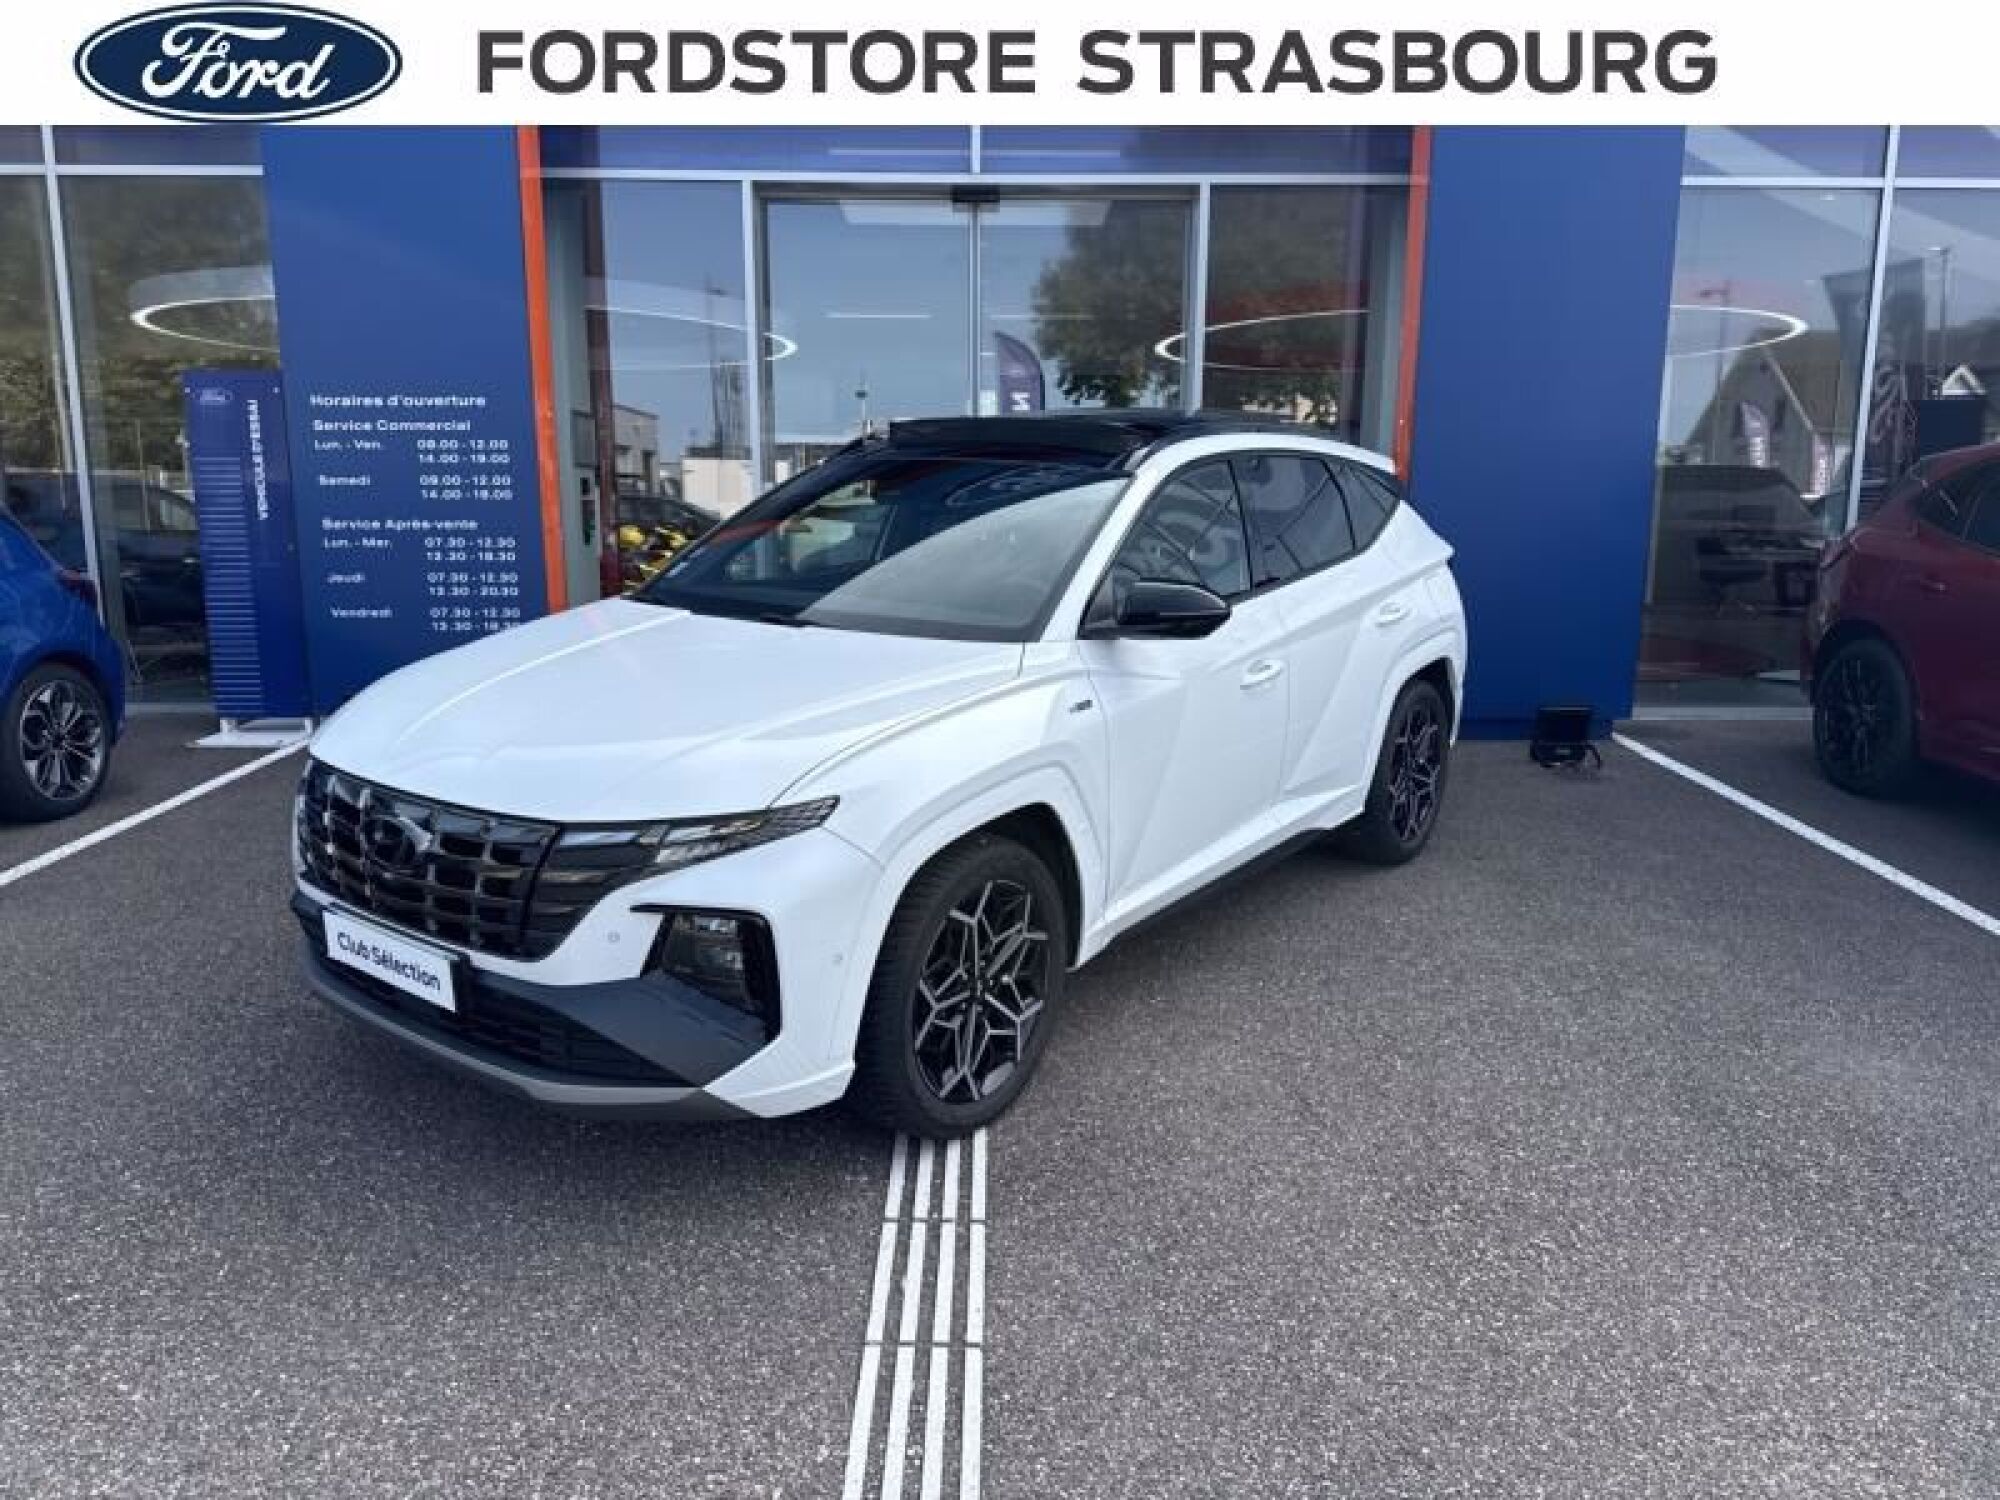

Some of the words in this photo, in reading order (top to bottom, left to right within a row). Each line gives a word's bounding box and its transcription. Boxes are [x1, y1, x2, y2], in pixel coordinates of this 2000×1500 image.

[310, 394, 384, 408] Horaires
[387, 394, 486, 408] d'ouverture
[313, 419, 373, 432] Service
[376, 419, 471, 432] Commercial
[319, 475, 371, 486] Samedi
[322, 518, 380, 531] Service
[331, 606, 392, 619] Vendredi
[337, 931, 371, 961] Club
